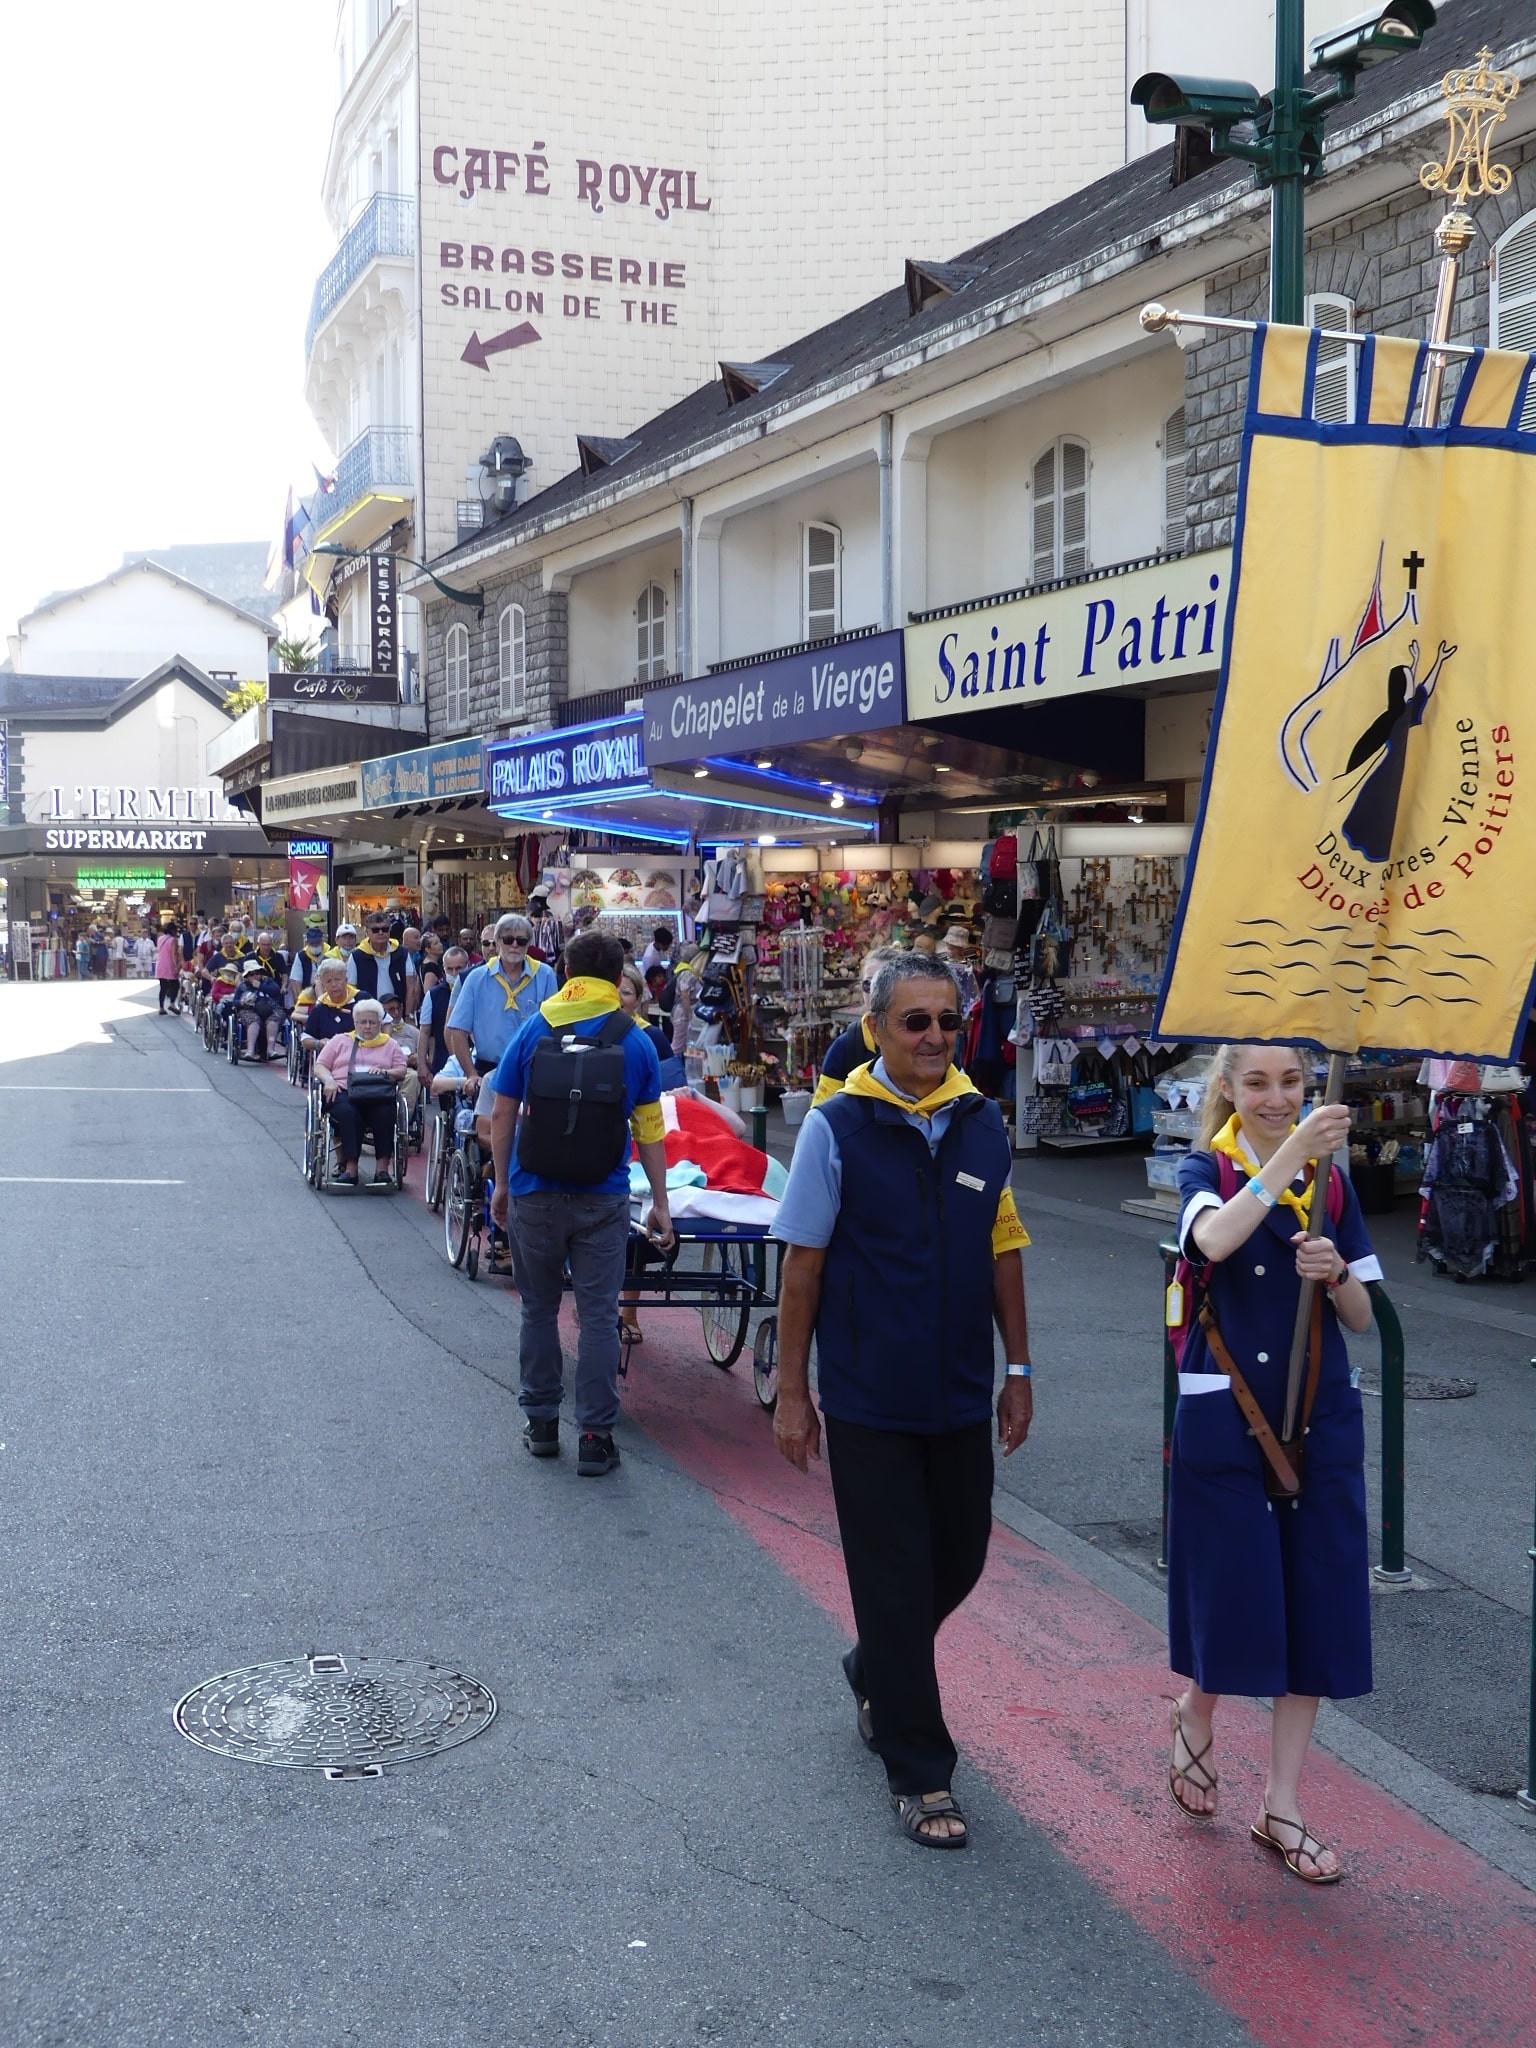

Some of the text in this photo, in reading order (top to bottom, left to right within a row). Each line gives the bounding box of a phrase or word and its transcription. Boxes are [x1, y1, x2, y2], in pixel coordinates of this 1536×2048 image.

[433, 141, 712, 220] CAFÉ ROYAL
[440, 242, 686, 288] BRASSERIE
[440, 284, 678, 326] SALON DE THE
[376, 557, 393, 672] RESTAURANT
[935, 574, 1218, 703] Saint Patri
[293, 678, 367, 700] Café Roya
[649, 661, 894, 742] Au Chapelet de la Vierge
[493, 733, 648, 797] PALAIS ROYAL
[1315, 831, 1371, 888] Deux
[1442, 717, 1479, 825] Vienne
[1403, 880, 1446, 910] de
[1450, 724, 1514, 879] Poitiers
[46, 829, 206, 850] SUPERMARKET
[77, 878, 166, 889] PARAPHARMACIE
